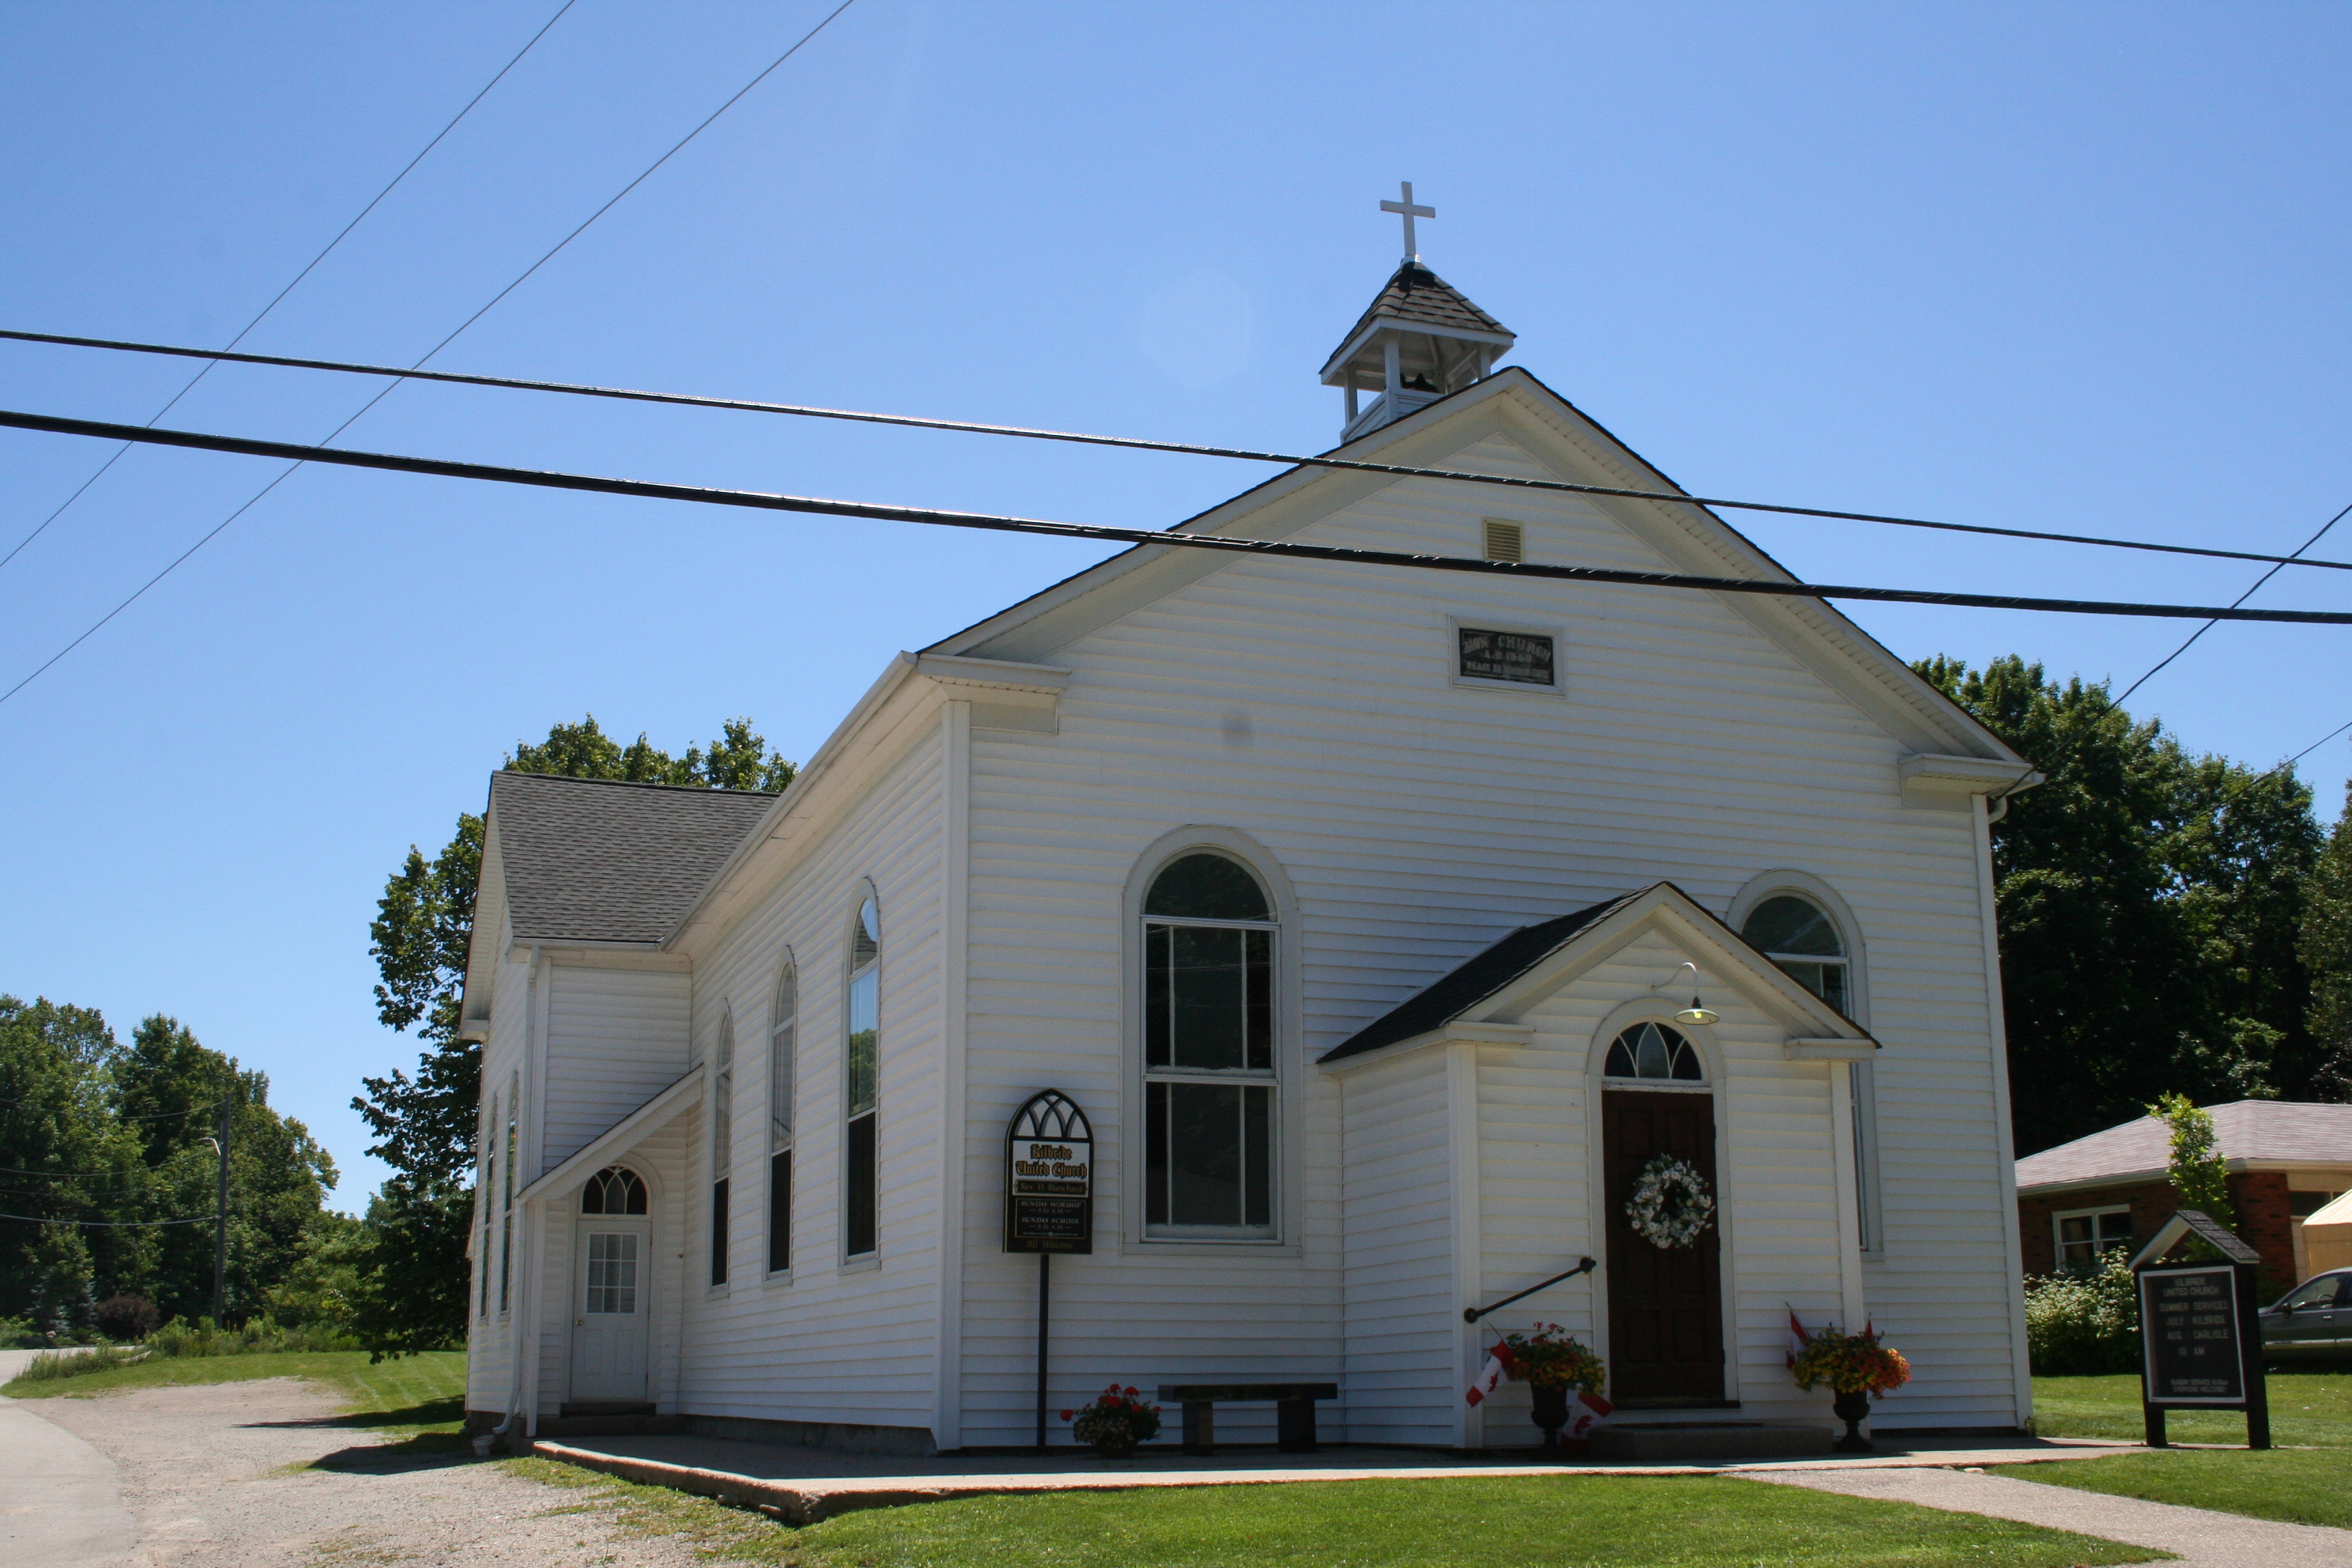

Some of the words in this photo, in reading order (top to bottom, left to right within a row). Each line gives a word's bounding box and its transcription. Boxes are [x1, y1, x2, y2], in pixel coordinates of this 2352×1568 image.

[1498, 635, 1551, 663] CHURCH
[1030, 1143, 1073, 1160] Kilbride
[1015, 1160, 1049, 1177] United
[1052, 1162, 1088, 1179] Church
[1020, 1183, 1036, 1191] Rev.
[1048, 1183, 1083, 1192] Blanchard
[2174, 1277, 2206, 1286] KILBRIDE
[2163, 1287, 2188, 1296] UNITED
[2189, 1286, 2219, 1296] CHURCH
[2159, 1302, 2189, 1312] SUMMER
[2193, 1301, 2228, 1311] SERVICES
[2192, 1315, 2226, 1325] KILBRIDE
[2193, 1329, 2229, 1339] CARLISLE
